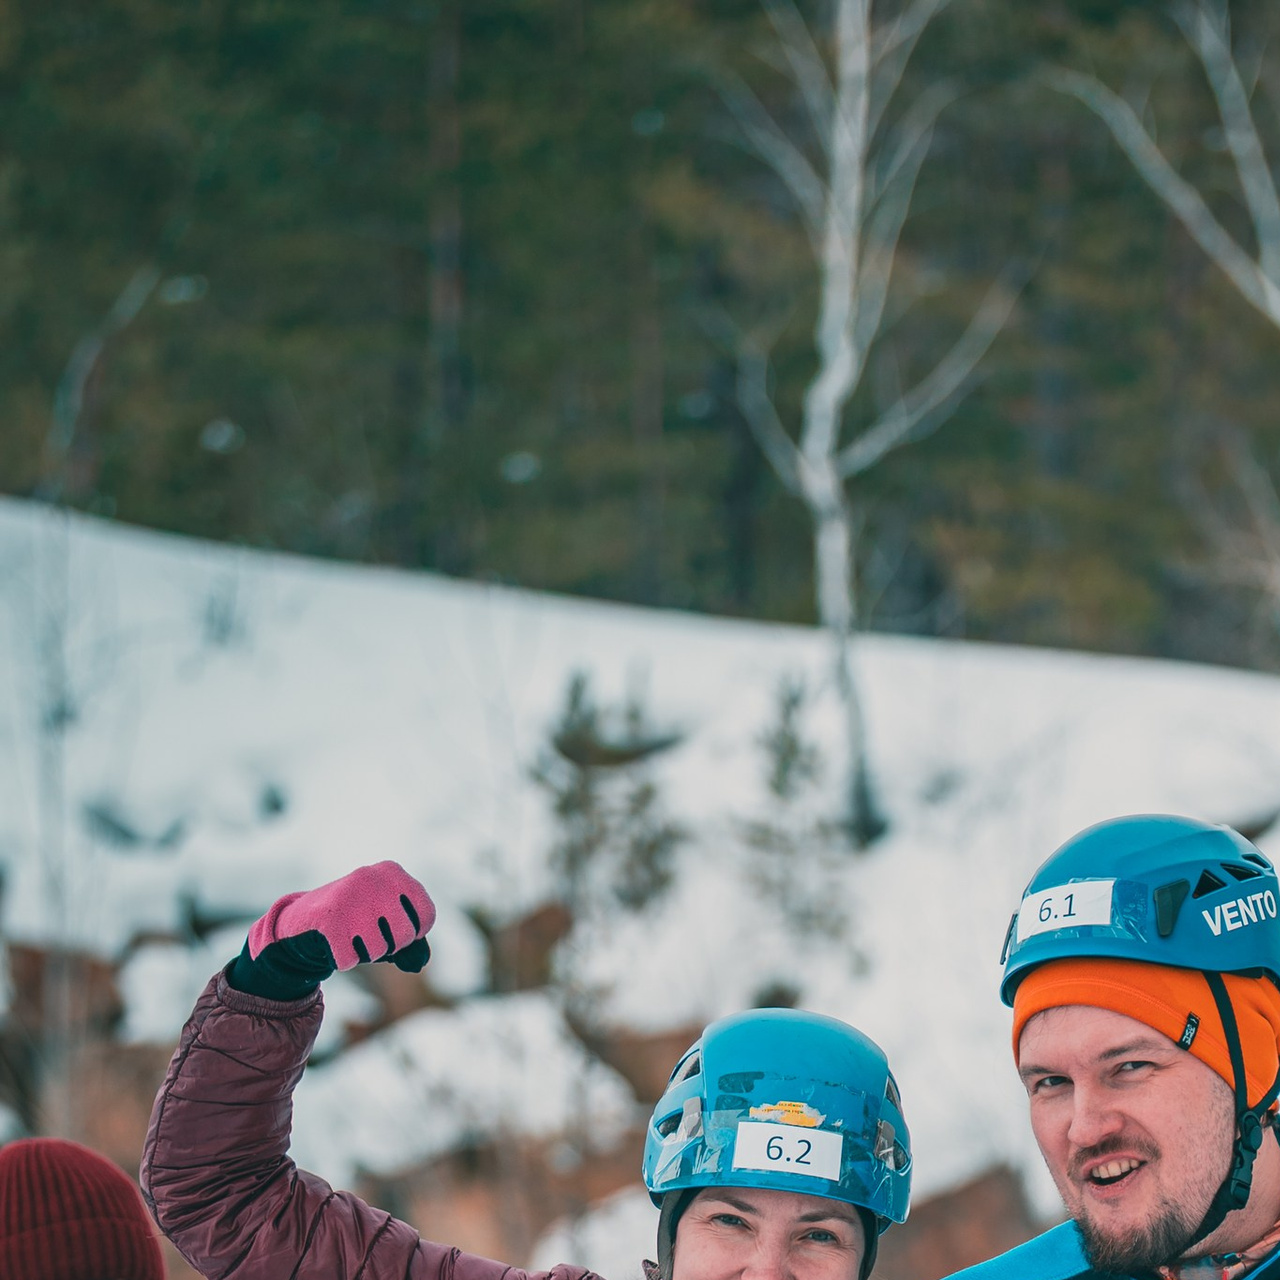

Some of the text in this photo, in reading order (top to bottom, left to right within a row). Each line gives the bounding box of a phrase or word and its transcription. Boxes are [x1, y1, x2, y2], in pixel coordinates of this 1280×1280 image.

[1037, 893, 1077, 923] 6.1
[1202, 889, 1278, 936] VENTO
[765, 1135, 813, 1166] 6.2
